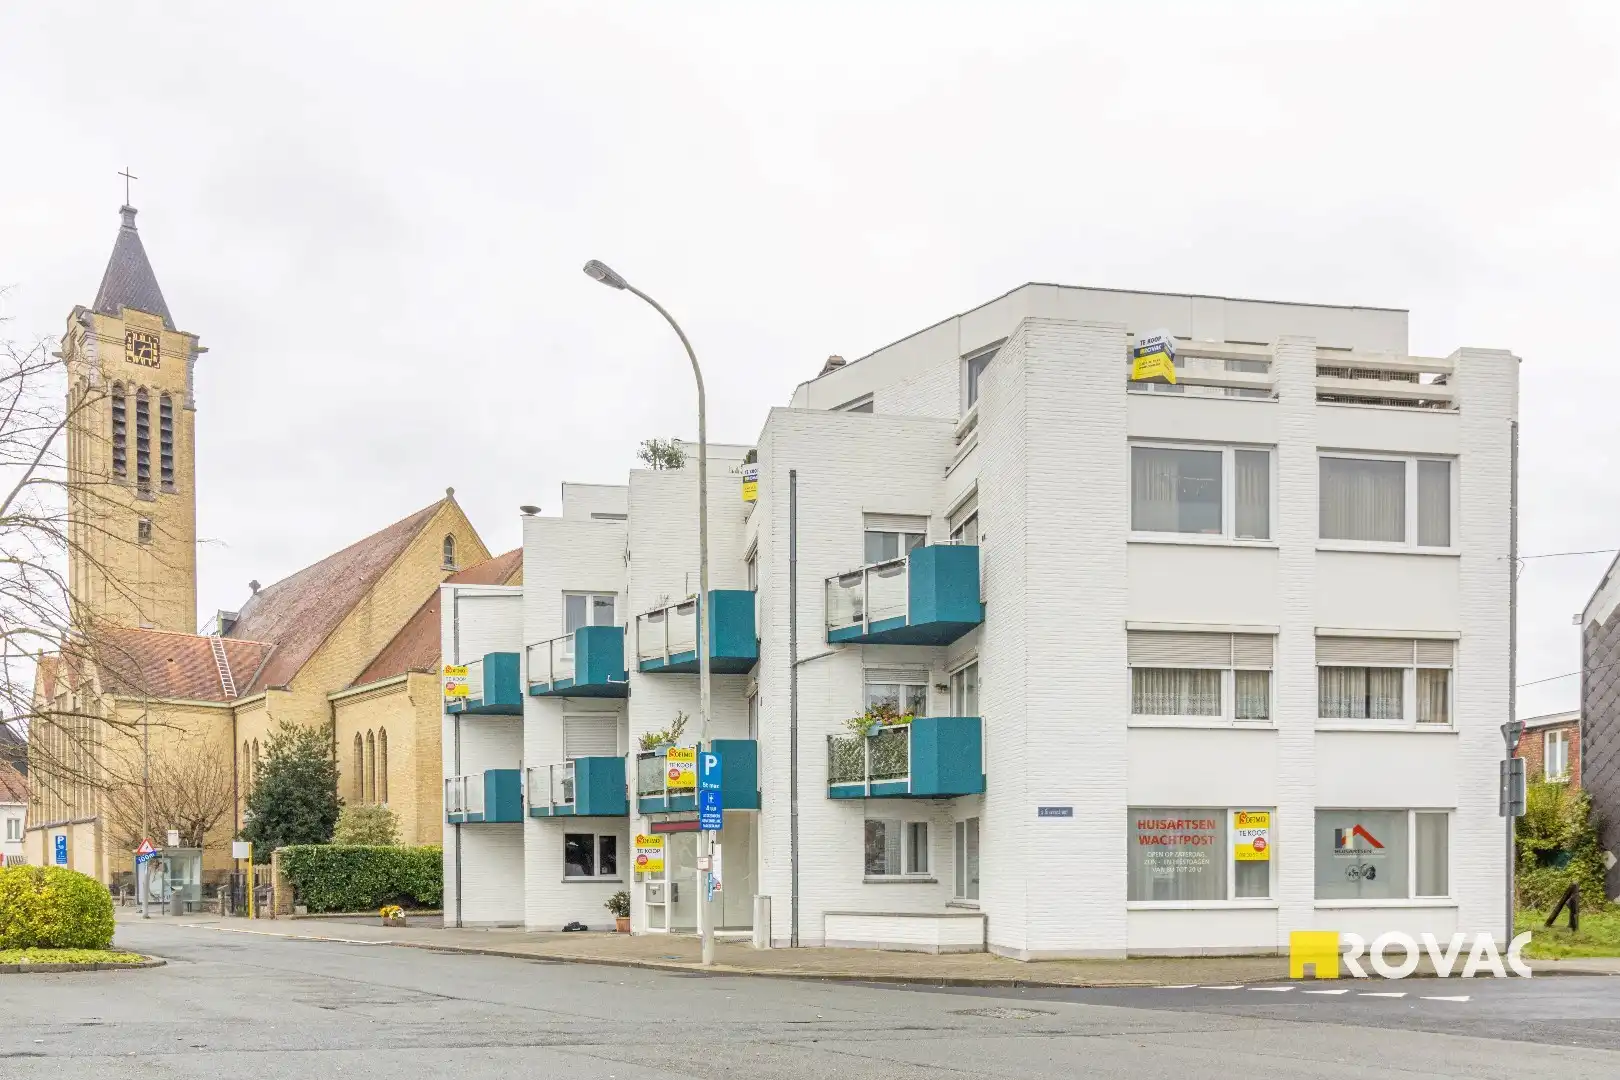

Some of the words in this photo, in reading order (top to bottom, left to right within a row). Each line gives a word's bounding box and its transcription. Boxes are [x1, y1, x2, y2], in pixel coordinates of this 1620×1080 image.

[705, 755, 718, 776] P
[1137, 819, 1216, 830] HUISARTSEN
[57, 836, 65, 844] P
[1139, 834, 1215, 846] WACHTPOST
[138, 852, 155, 863] 100m
